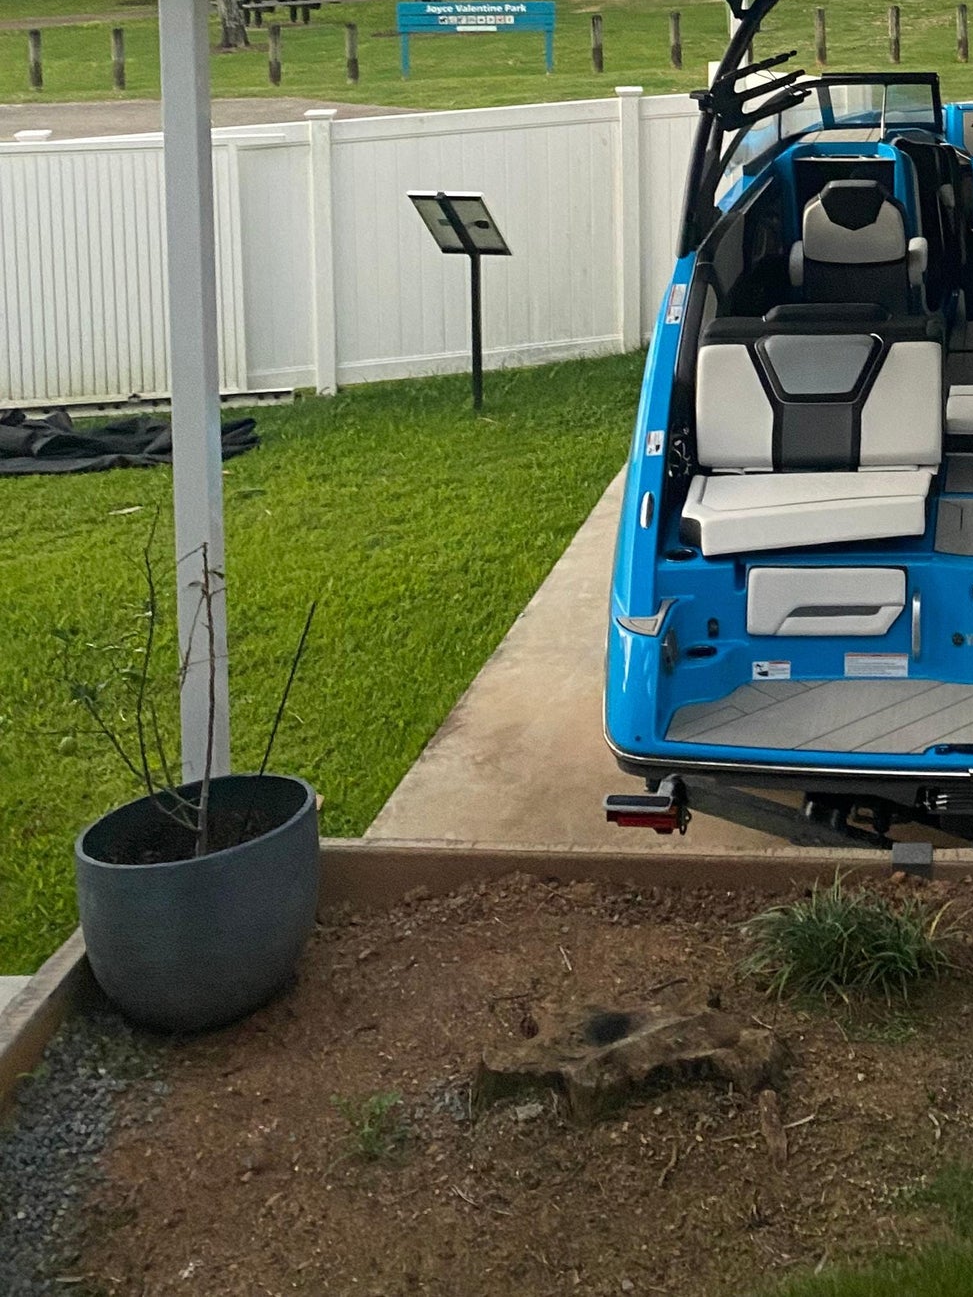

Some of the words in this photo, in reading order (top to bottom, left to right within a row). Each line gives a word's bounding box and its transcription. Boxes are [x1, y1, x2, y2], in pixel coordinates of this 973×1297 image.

[426, 4, 453, 14] Joyce
[455, 4, 503, 13] Valentine
[504, 3, 527, 13] Park
